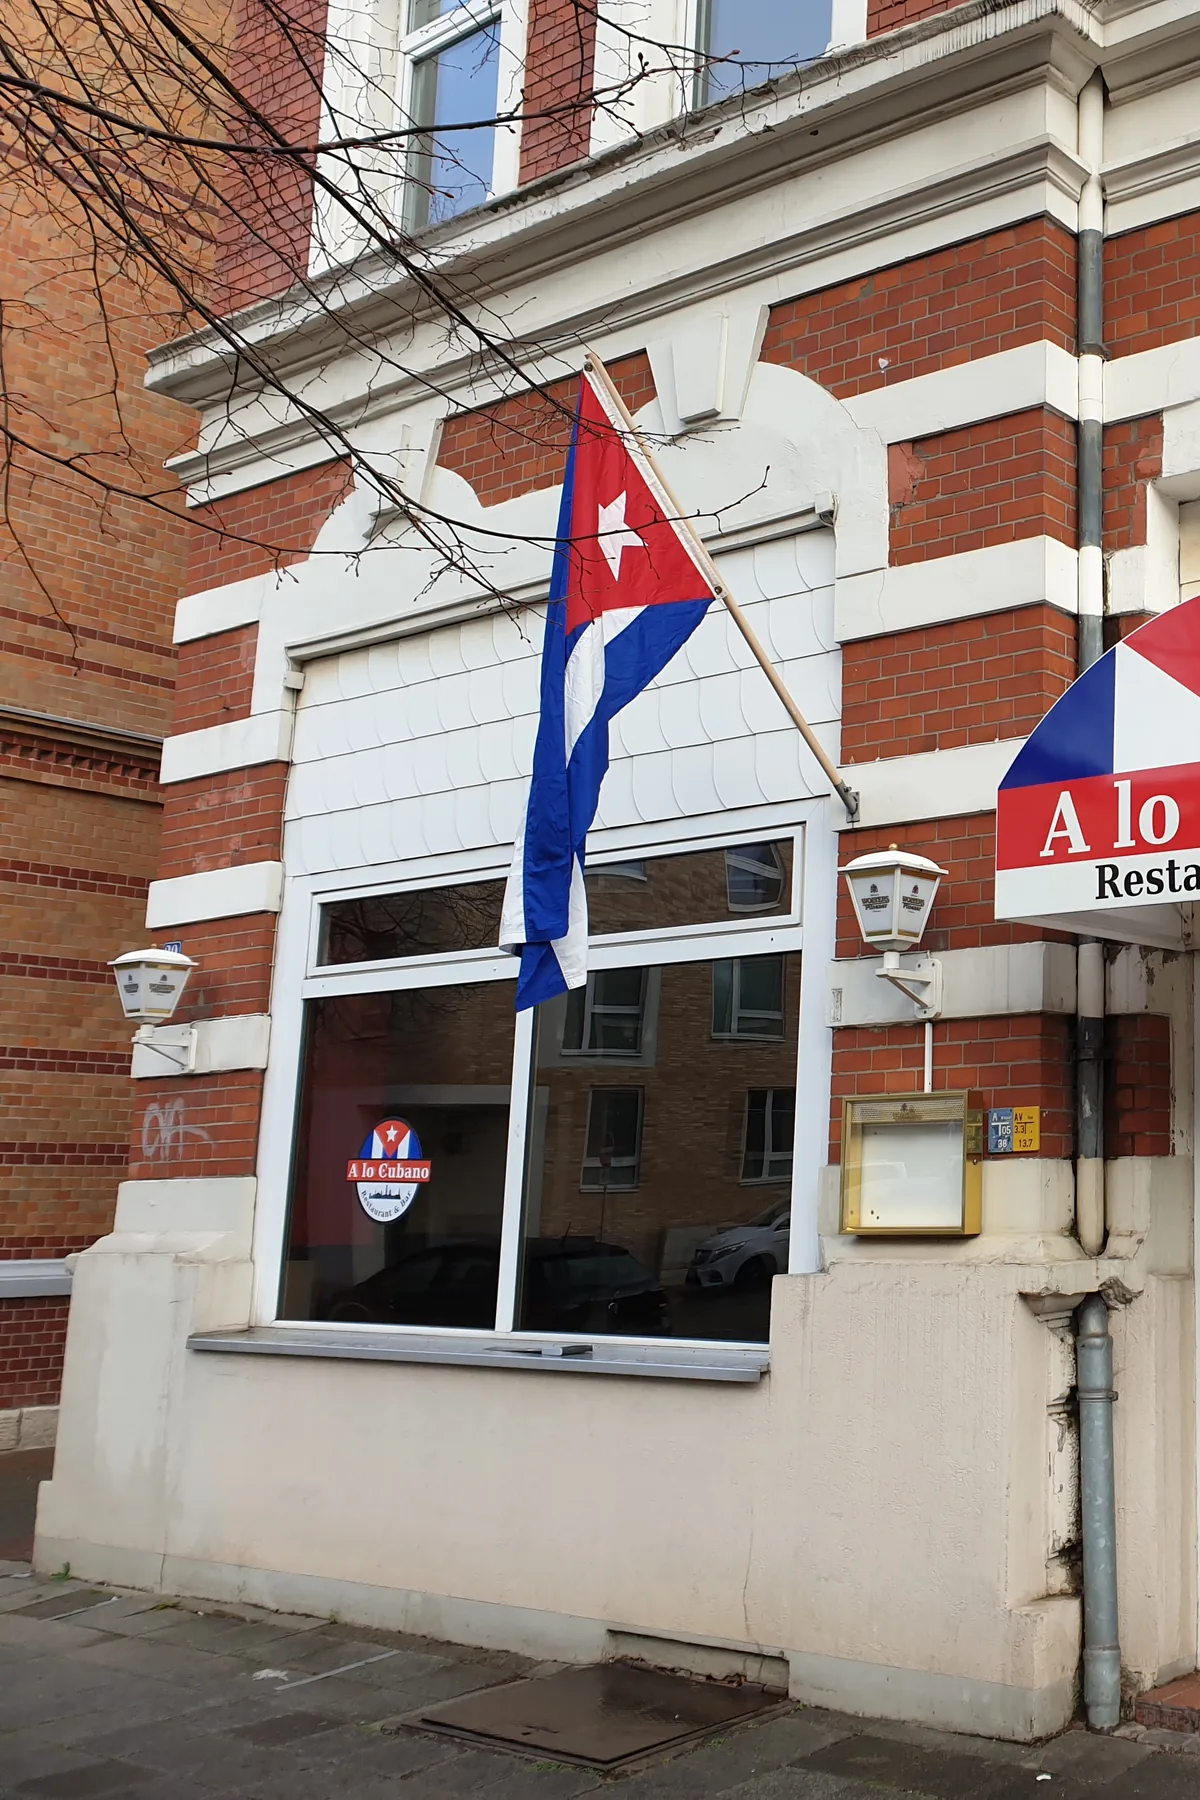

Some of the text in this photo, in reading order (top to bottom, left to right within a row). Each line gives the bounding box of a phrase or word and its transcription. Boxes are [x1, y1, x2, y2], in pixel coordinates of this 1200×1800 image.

[1040, 790, 1091, 857] A
[1113, 779, 1180, 849] lo
[1014, 1112, 1023, 1121] AV
[997, 1139, 1008, 1148] 38
[348, 1162, 429, 1179] A lo Cubano
[361, 1190, 393, 1217] Restaurant
[400, 1190, 412, 1208] Bar
